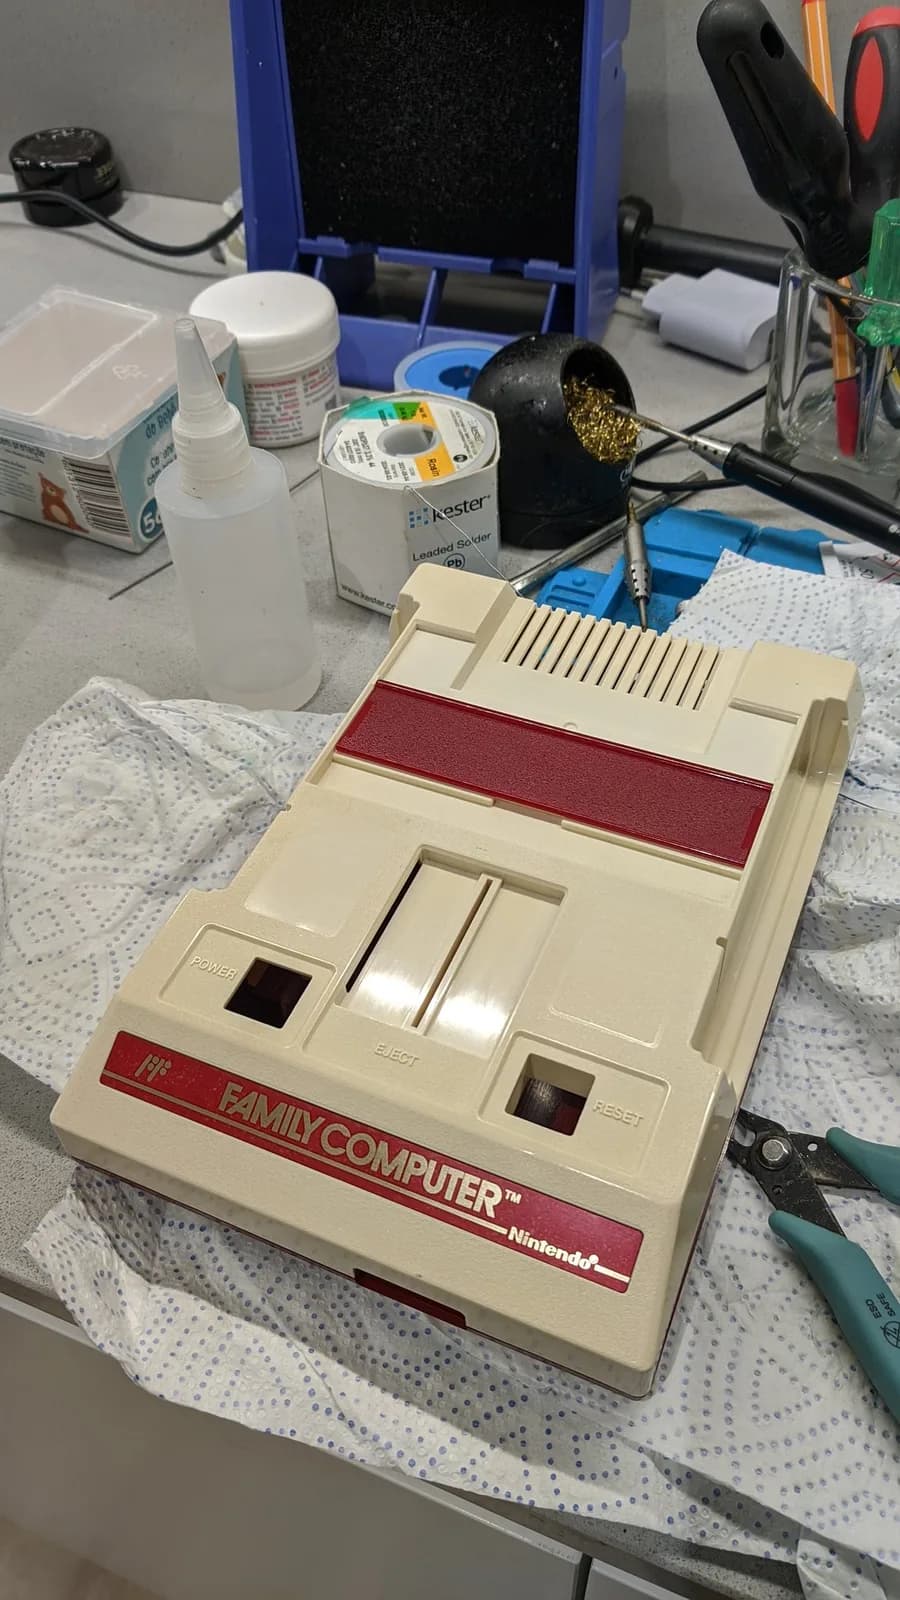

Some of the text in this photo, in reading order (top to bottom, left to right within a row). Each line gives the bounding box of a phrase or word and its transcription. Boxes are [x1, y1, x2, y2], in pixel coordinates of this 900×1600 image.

[429, 458, 440, 477] Rosin
[432, 494, 490, 523] kester
[412, 533, 492, 562] Leaded Solder
[447, 558, 463, 568] Pb
[190, 955, 240, 981] POWER
[374, 1043, 420, 1068] EJECT
[218, 1081, 325, 1145] FAMILY
[592, 1100, 644, 1128] RESET
[508, 1226, 598, 1271] Nintendo
[865, 1299, 882, 1319] ESD
[876, 1292, 896, 1317] SAFE
